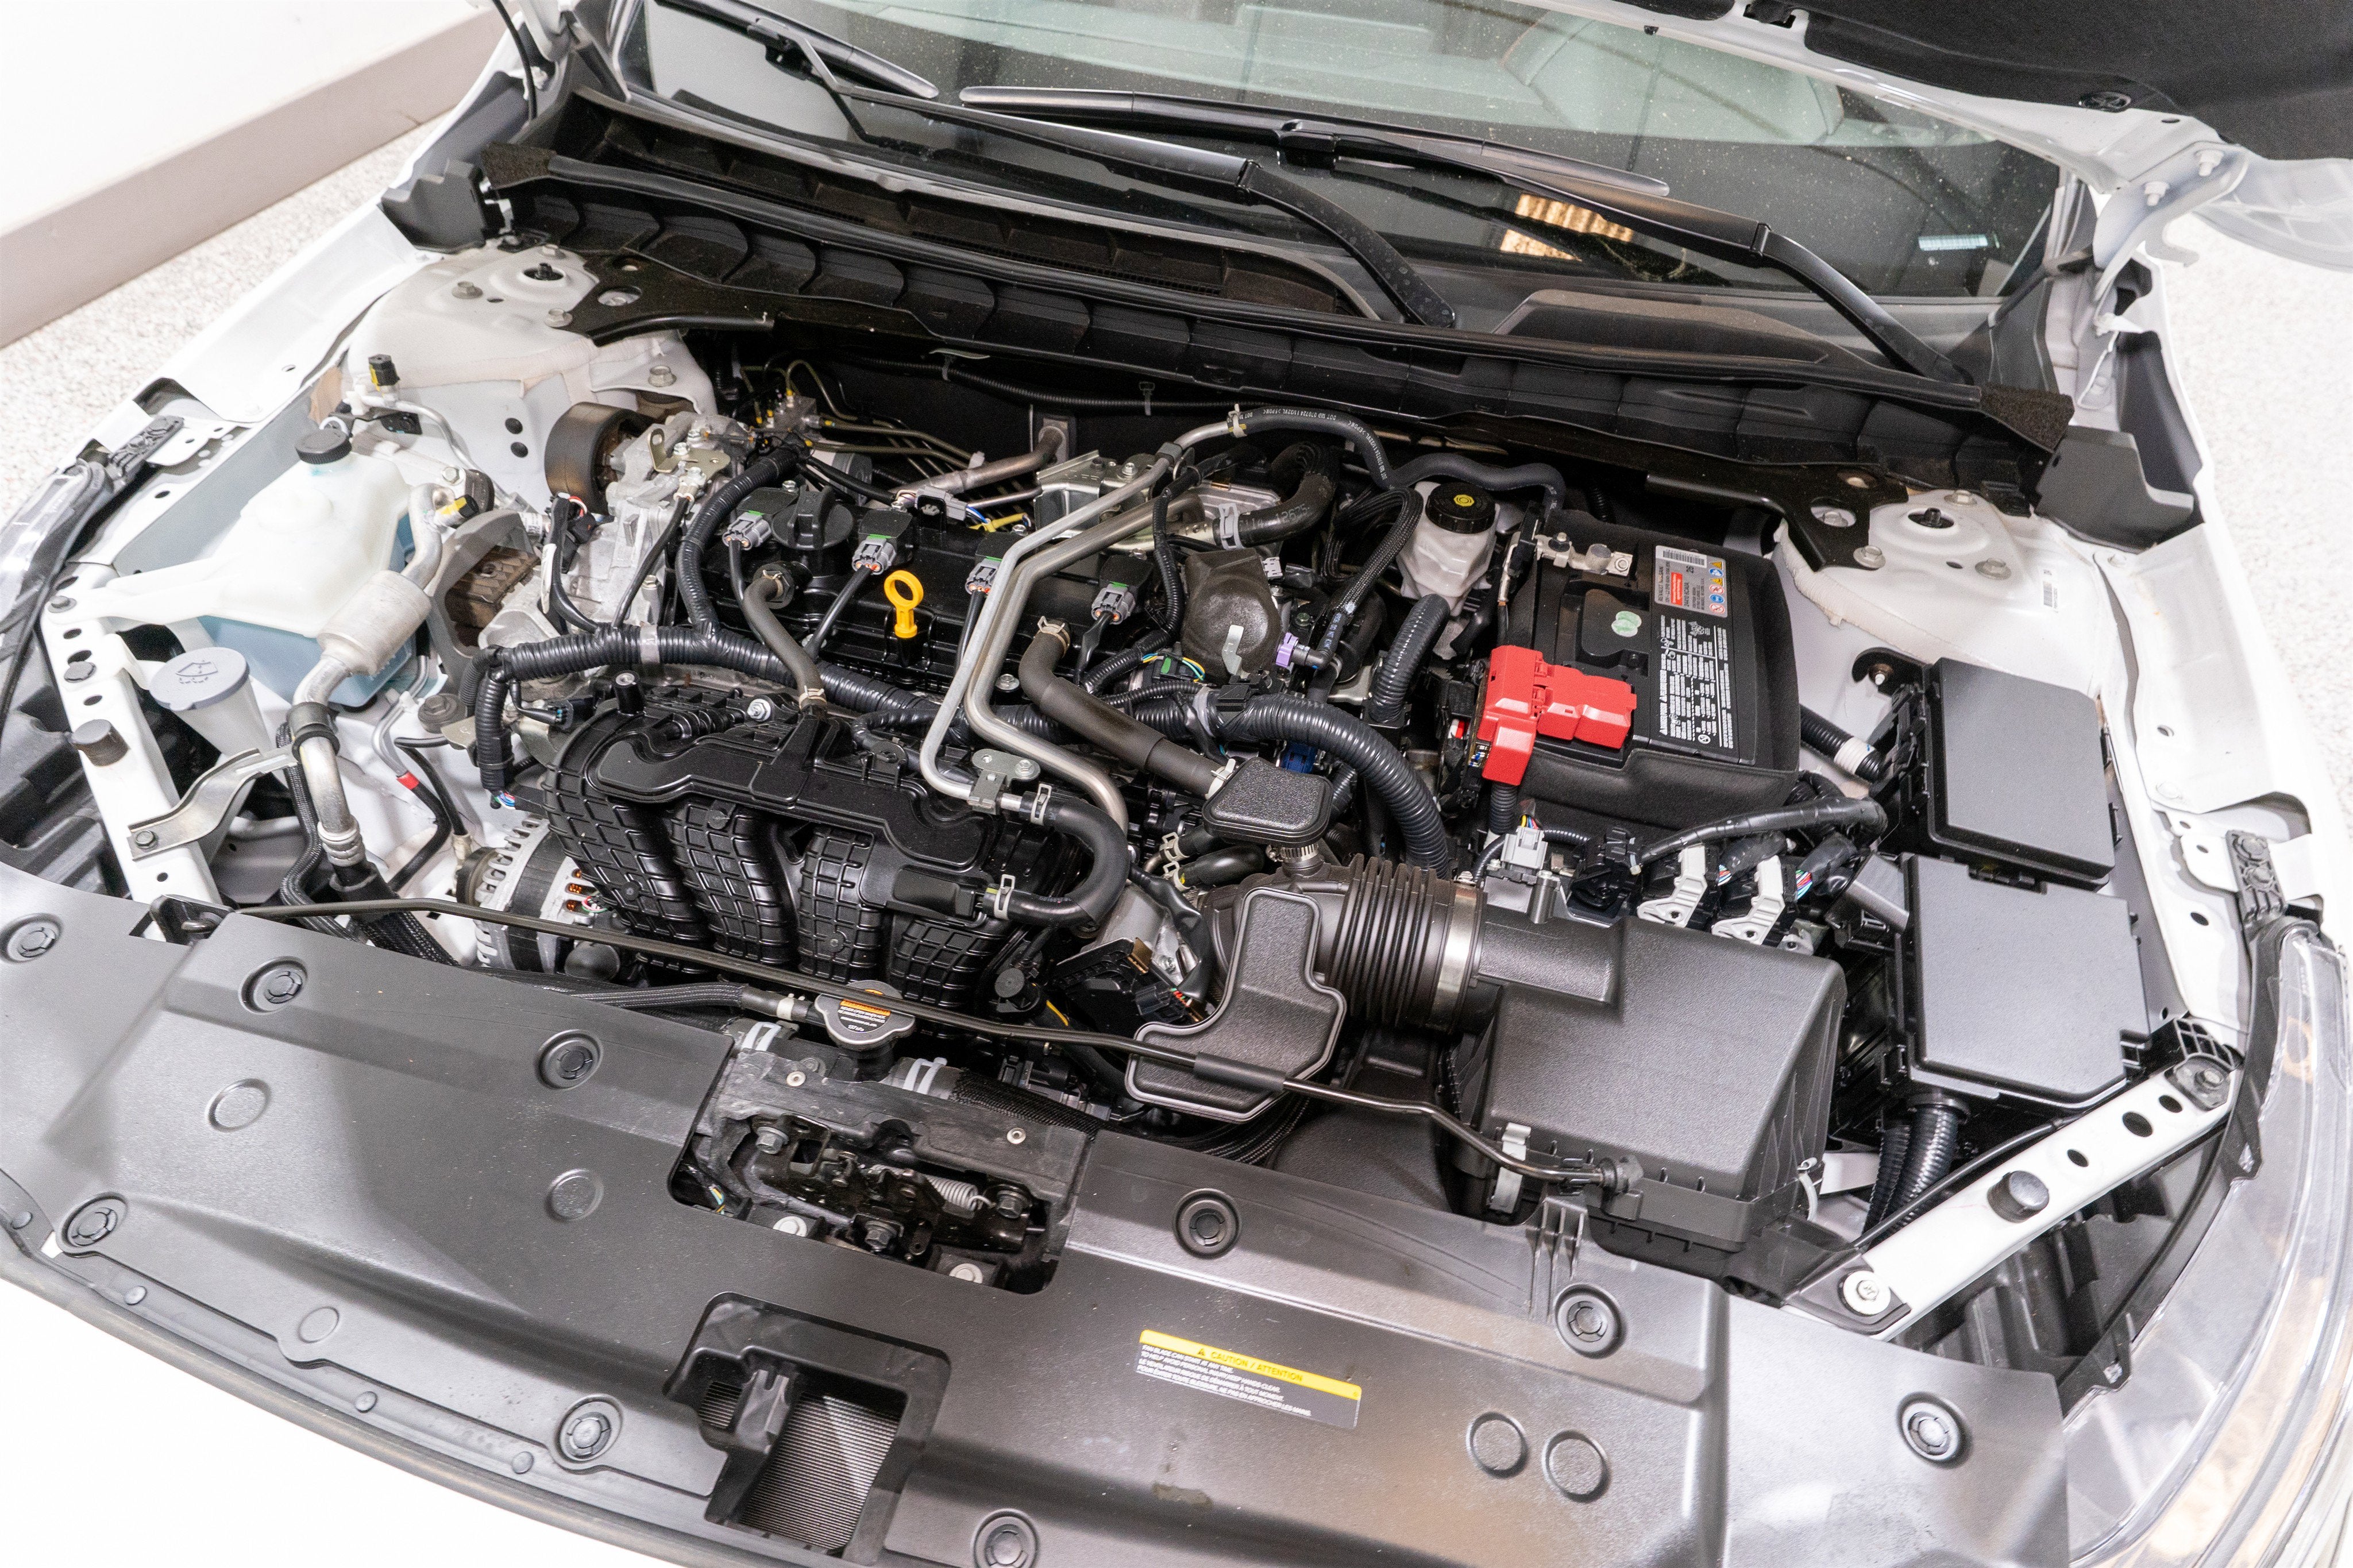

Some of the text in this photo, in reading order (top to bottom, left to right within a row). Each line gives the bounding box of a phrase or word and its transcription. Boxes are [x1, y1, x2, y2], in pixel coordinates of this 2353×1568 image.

[1375, 450, 1383, 466] 070724
[1171, 1352, 1184, 1360] CAN
[1136, 1364, 1154, 1373] POUR
[1148, 1353, 1164, 1362] HELP
[1240, 1377, 1262, 1388] HANDS
[1210, 1351, 1249, 1369] CAUTION
[1257, 1363, 1304, 1382] ATTENTION
